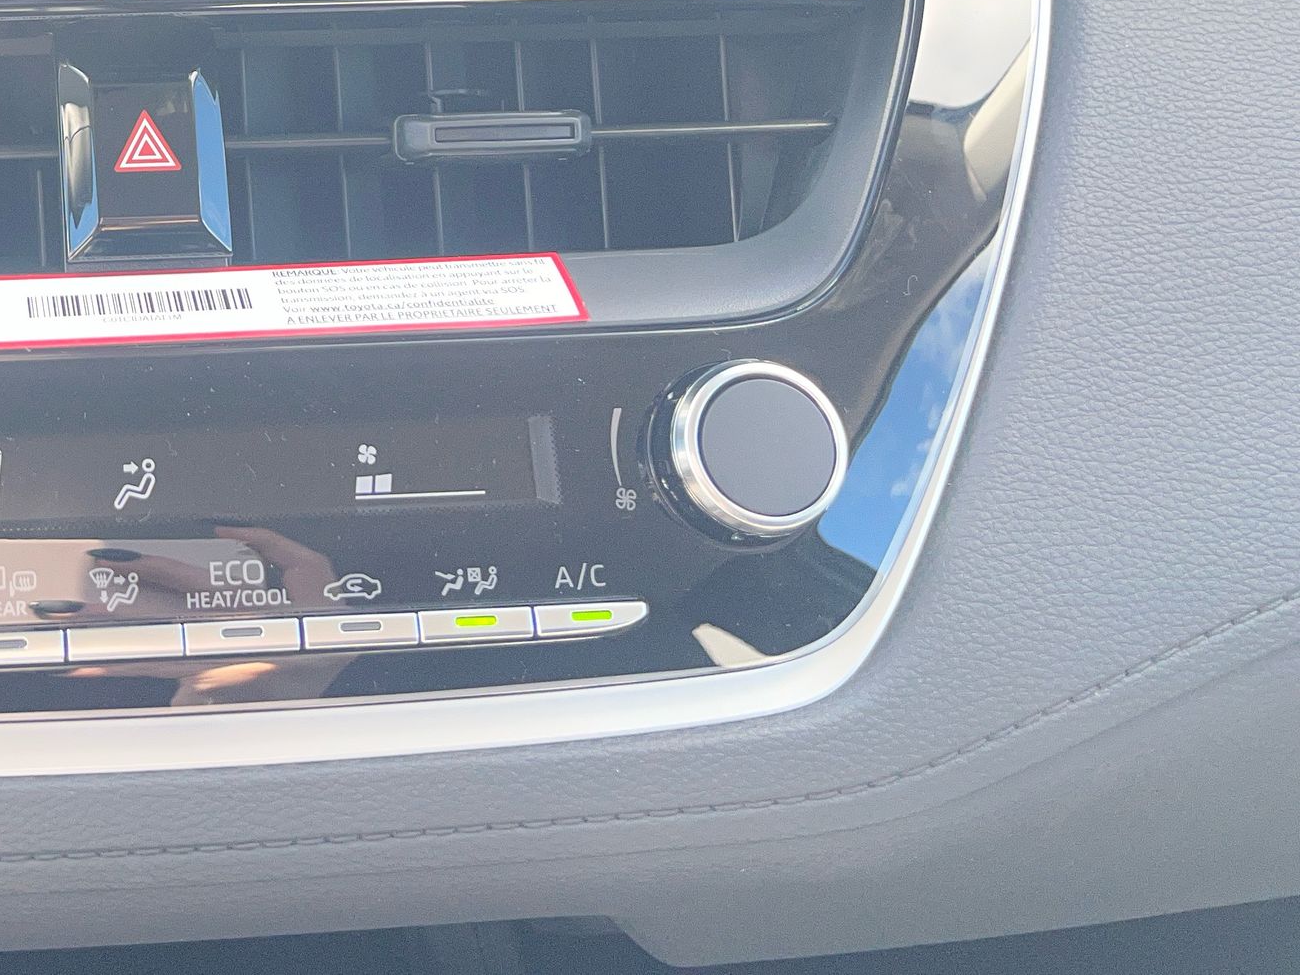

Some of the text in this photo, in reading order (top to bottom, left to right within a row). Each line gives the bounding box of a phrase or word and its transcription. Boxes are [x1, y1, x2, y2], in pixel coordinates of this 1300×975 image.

[445, 261, 506, 269] transmettre
[365, 273, 431, 282] localisation
[449, 270, 501, 279] appuyant
[278, 287, 319, 295] bouton
[298, 314, 351, 324] ENLEVER
[355, 313, 378, 321] PAR
[380, 312, 395, 321] LE
[485, 305, 558, 315] SEULEMENT
[208, 560, 265, 586] ECO
[555, 564, 607, 589] A/C
[186, 587, 291, 610] HEAT/COOL
